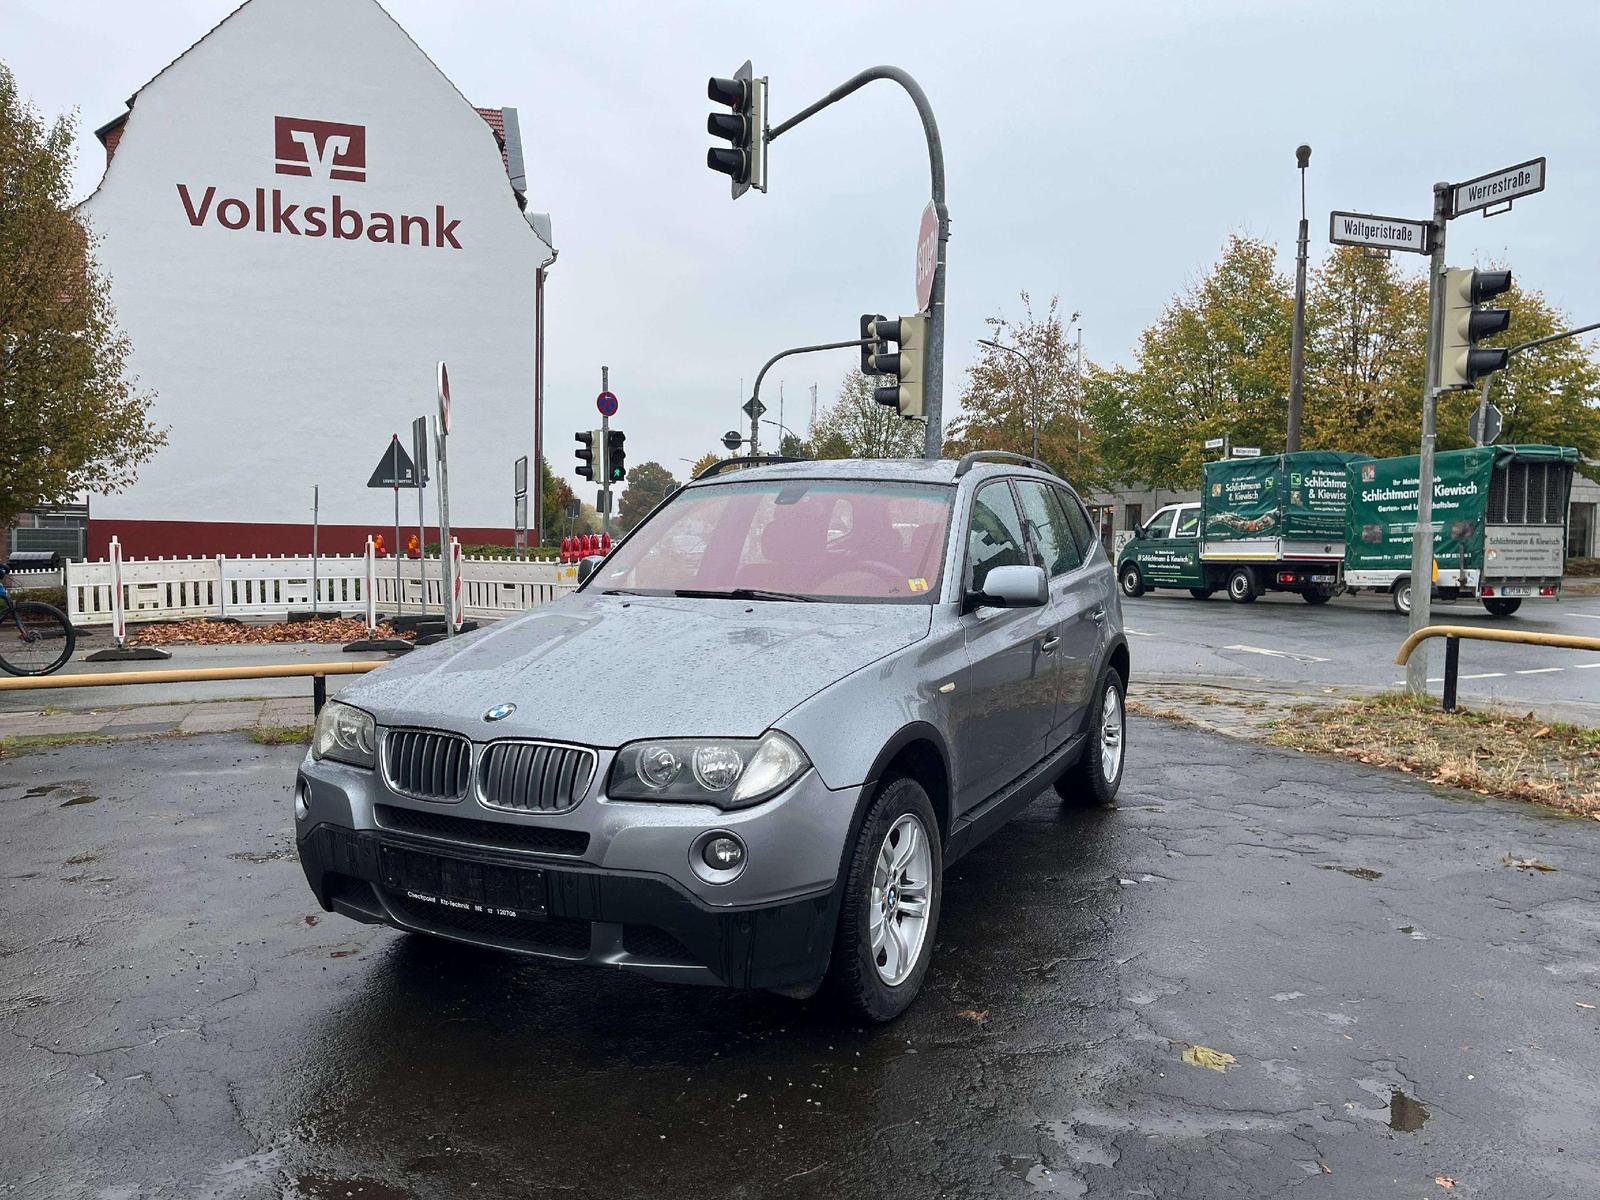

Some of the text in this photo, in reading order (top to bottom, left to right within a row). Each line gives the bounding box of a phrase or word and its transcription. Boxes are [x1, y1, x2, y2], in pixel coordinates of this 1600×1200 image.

[1468, 171, 1531, 202] Werrestraße
[176, 183, 463, 250] Volksbank
[1344, 219, 1413, 242] Waltgeristraße
[1304, 477, 1347, 488] Schlichtma
[1434, 481, 1478, 497] Kiewisch
[1318, 489, 1347, 500] Kiewisc
[1401, 503, 1412, 511] und
